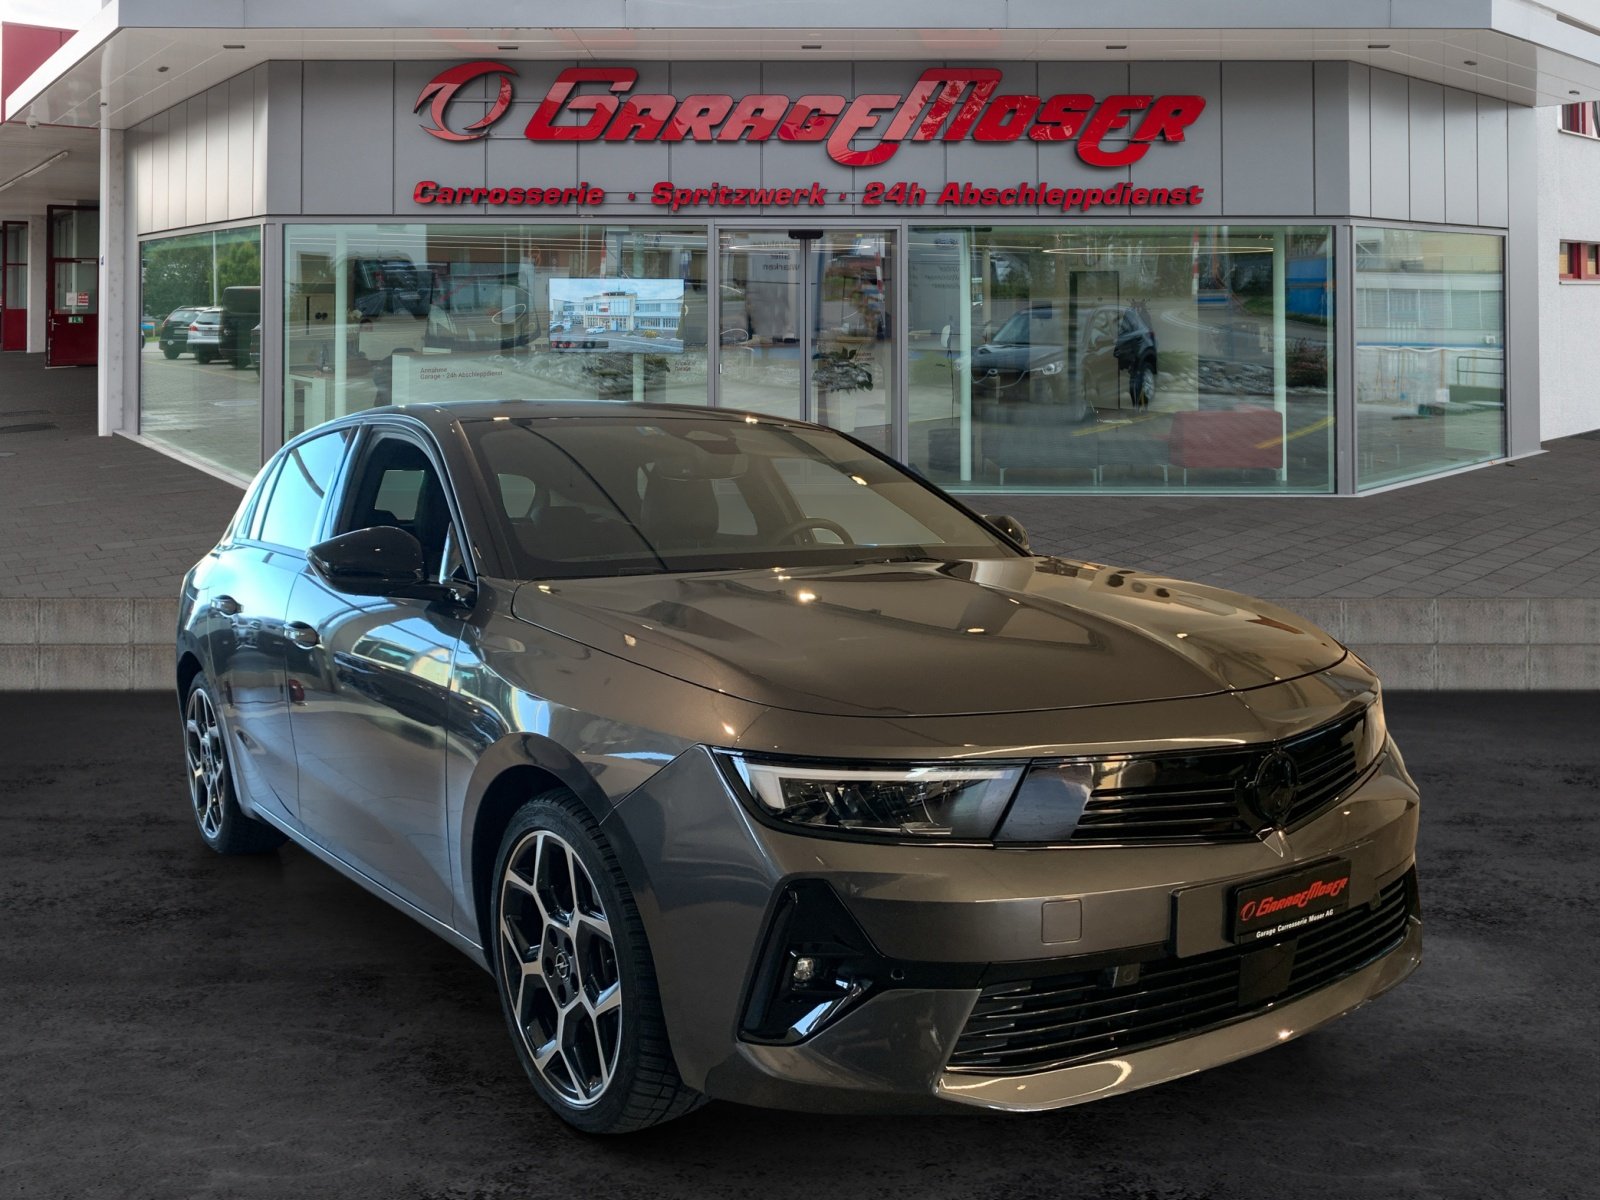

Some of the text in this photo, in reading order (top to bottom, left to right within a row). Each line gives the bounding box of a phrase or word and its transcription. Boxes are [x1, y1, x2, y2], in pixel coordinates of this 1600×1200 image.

[413, 180, 1205, 212] Carrosserie Spritzwerk 24h Abschleppdienst
[420, 373, 441, 381] Garage
[1256, 908, 1334, 939] Garage Carrosserie Moser AG
